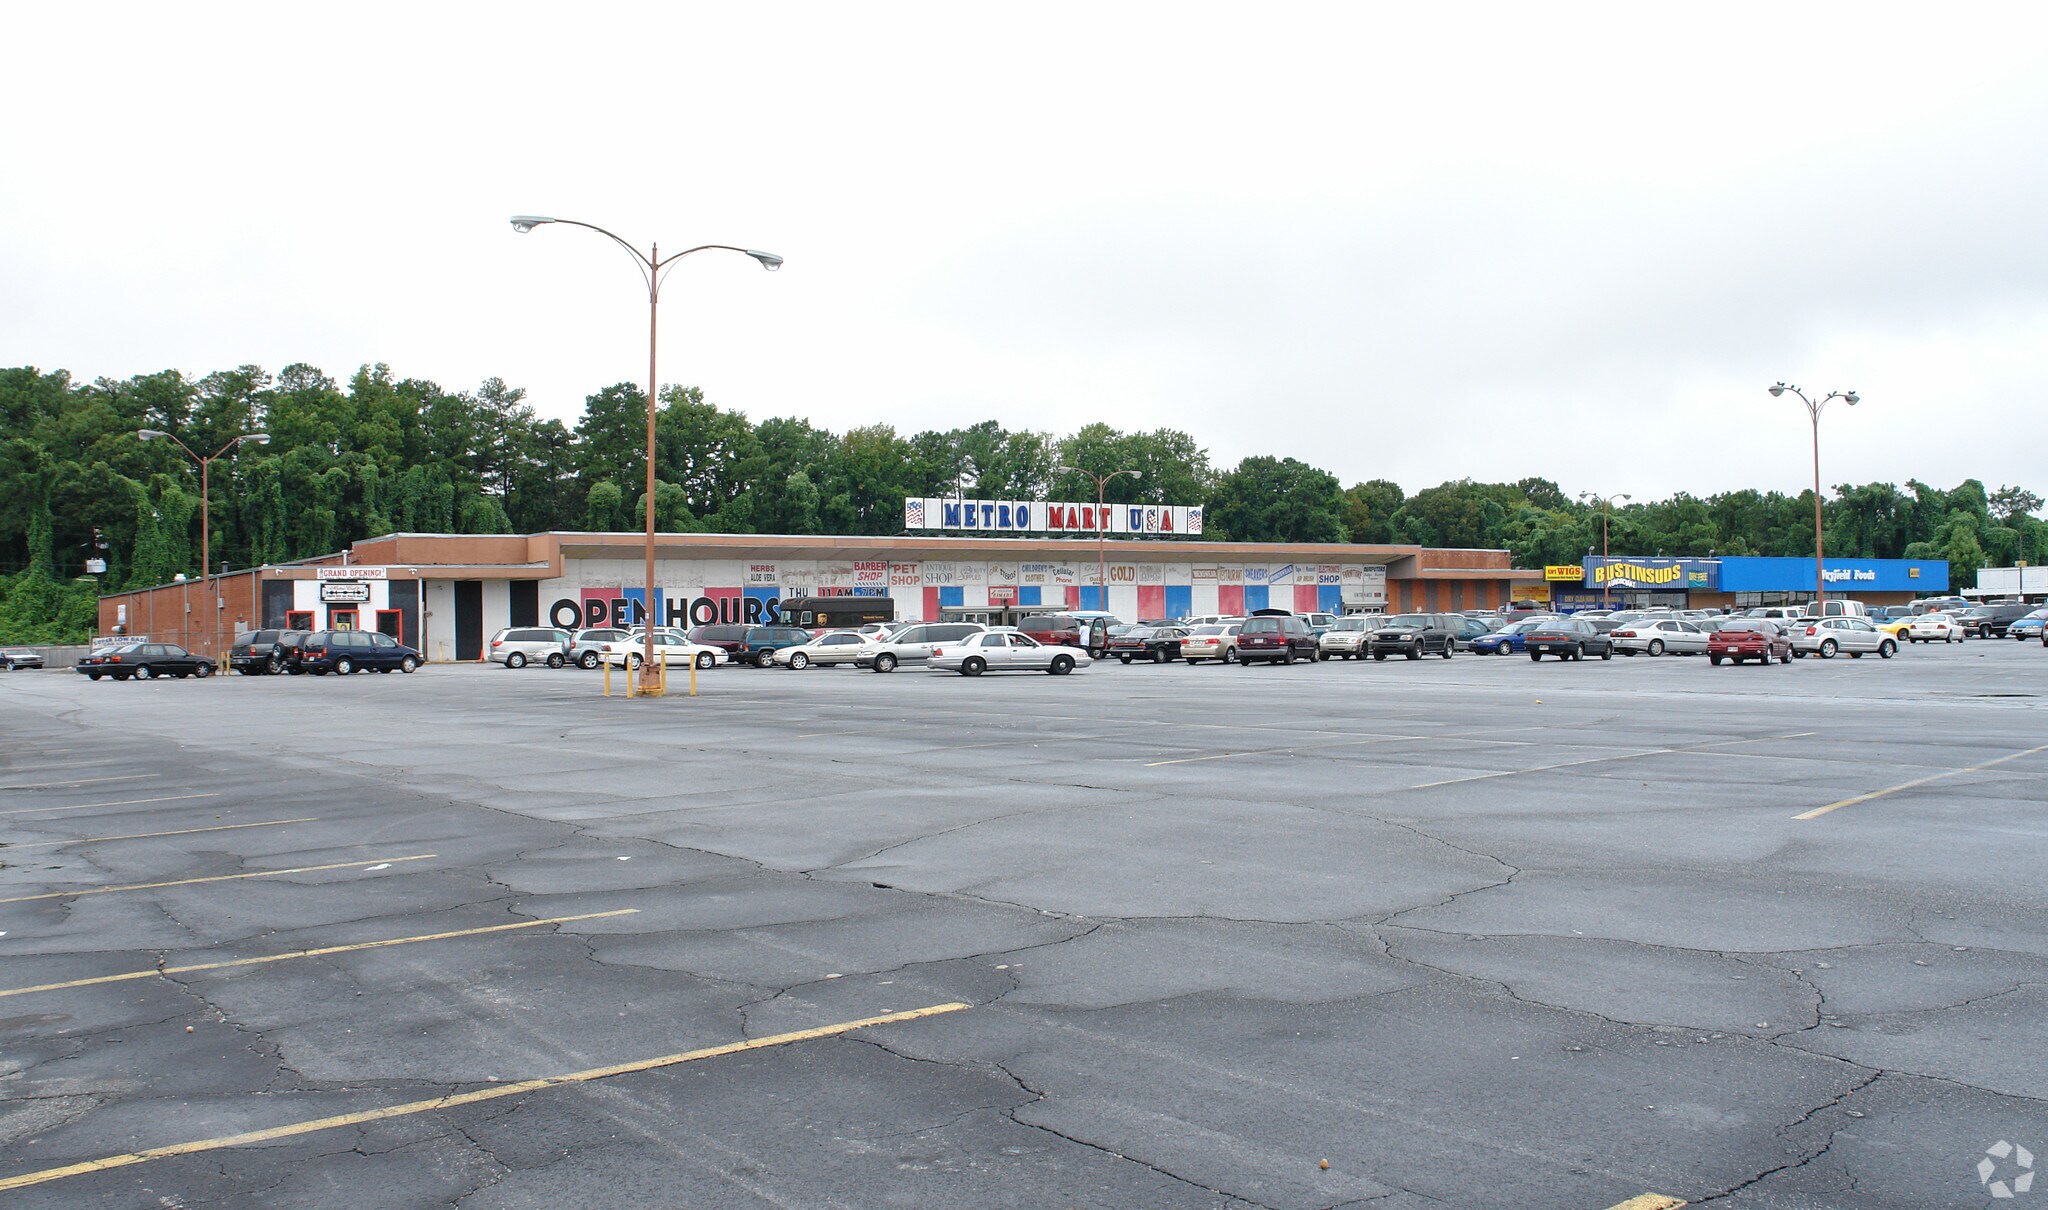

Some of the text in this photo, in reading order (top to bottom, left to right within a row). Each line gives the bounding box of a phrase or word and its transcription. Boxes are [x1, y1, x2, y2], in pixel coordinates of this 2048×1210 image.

[945, 503, 1173, 531] METRO MART USA
[750, 565, 776, 573] HERBS
[854, 562, 887, 571] BARBER
[893, 564, 917, 574] PET
[925, 564, 953, 572] ANTIQUE
[1557, 567, 1581, 576] WIGS
[323, 569, 382, 577] GRAND OPENING!
[858, 571, 883, 581] SHOP
[1053, 567, 1075, 577] Cellular
[1110, 566, 1135, 582] GOLD
[1595, 563, 1681, 584] BUSTINSUDS
[1853, 570, 1876, 581] Foods
[750, 574, 776, 582] ALOE VERA
[891, 575, 920, 586] SHOP
[925, 573, 953, 584] SHOP
[1319, 575, 1340, 583] SHOP
[789, 588, 809, 598] THU
[822, 588, 832, 597] 11
[836, 588, 853, 597] AM
[550, 597, 780, 632] OPEN HOURS
